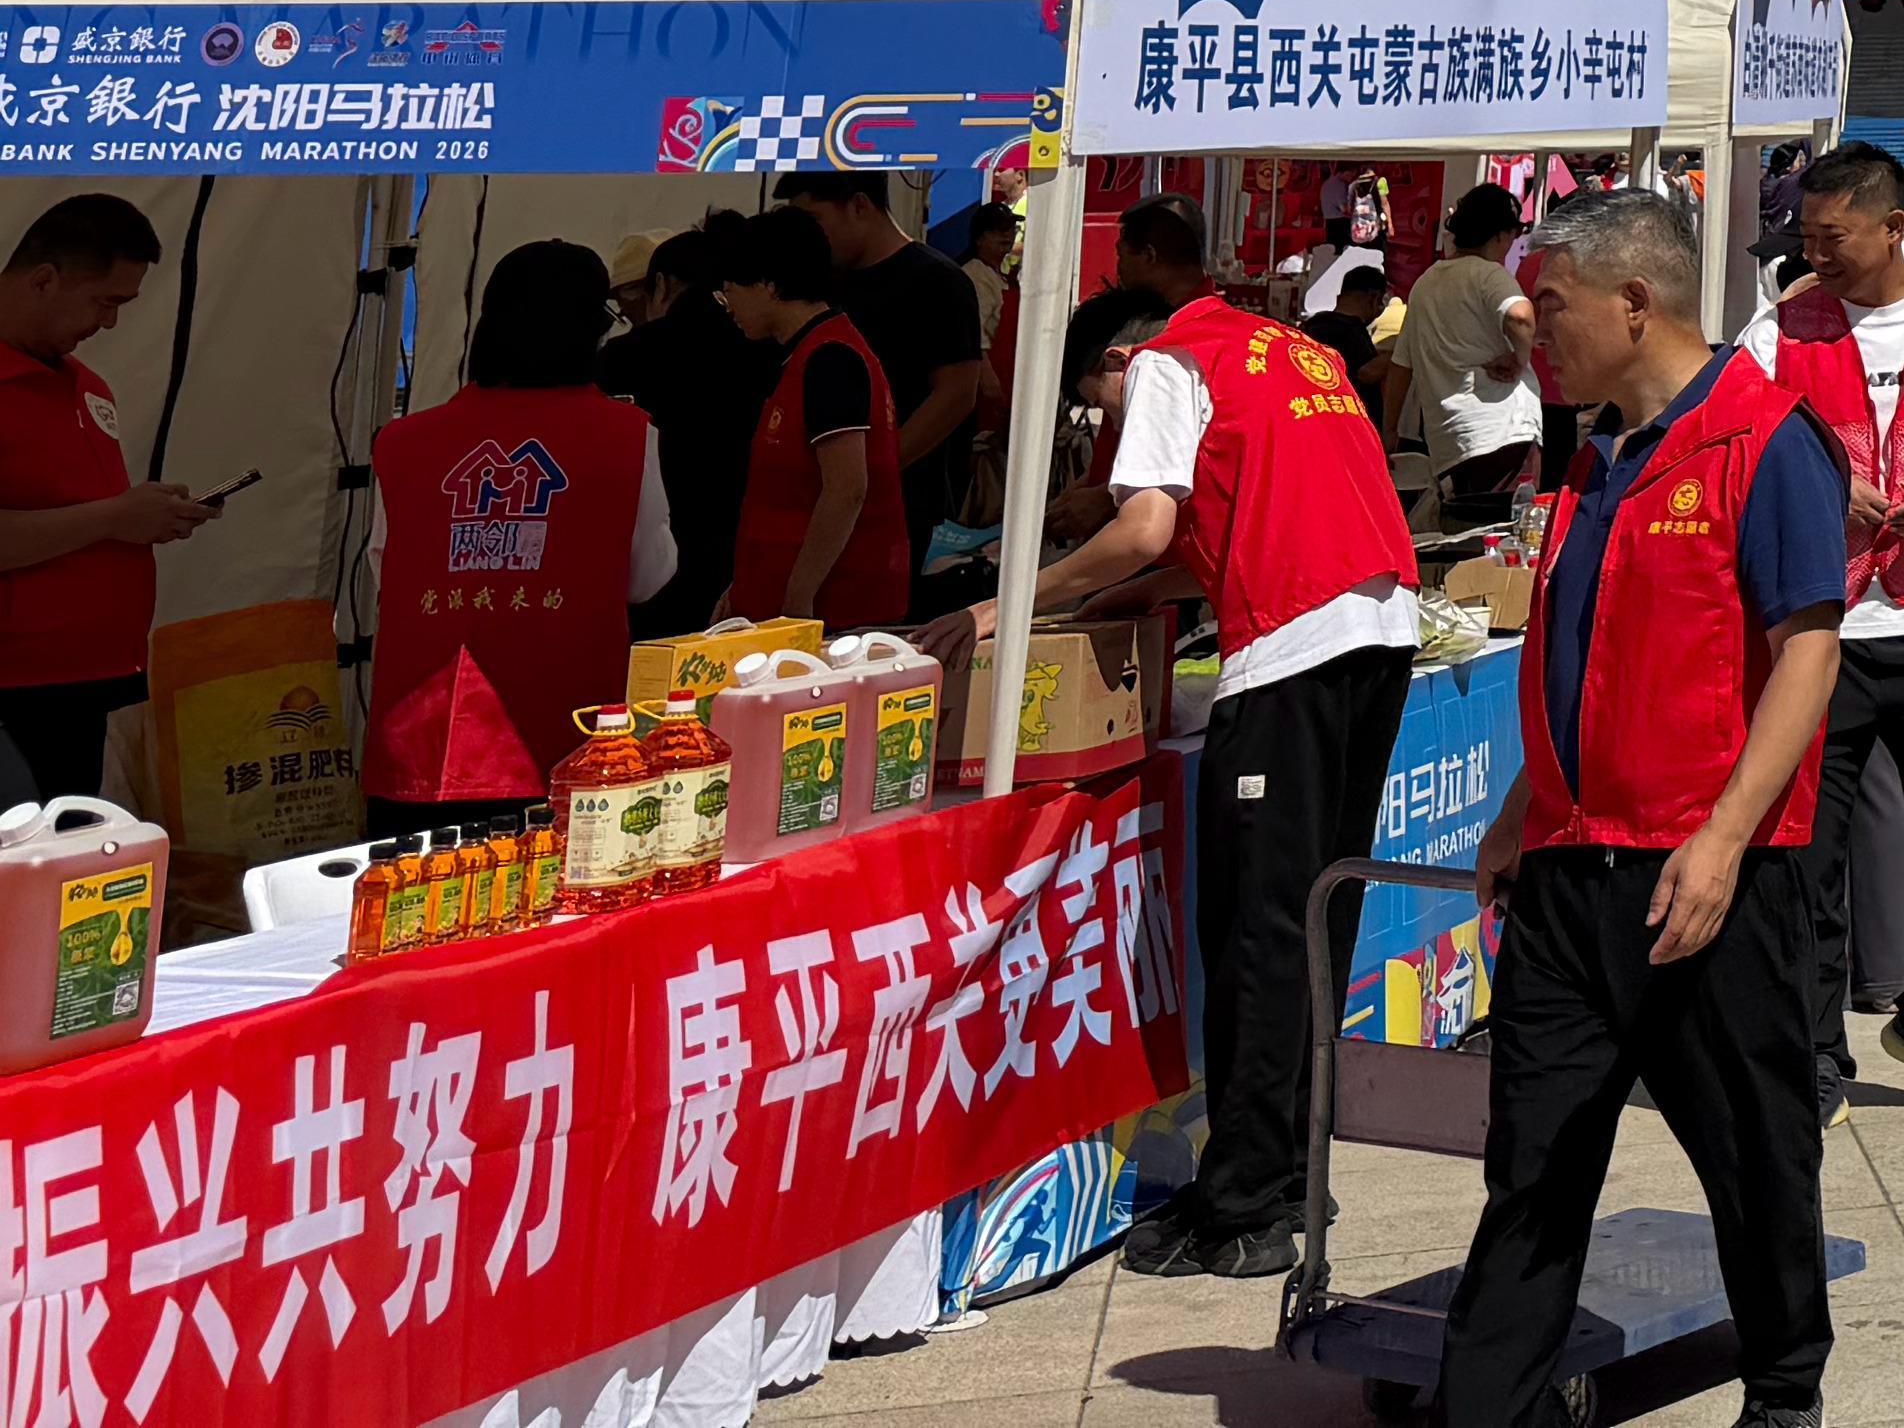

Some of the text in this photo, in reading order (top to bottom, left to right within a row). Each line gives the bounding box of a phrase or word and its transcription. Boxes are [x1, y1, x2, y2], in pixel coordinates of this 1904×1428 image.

[67, 54, 182, 64] SHENGJING BANK
[71, 25, 187, 52] 盛京銀行
[1135, 20, 1647, 115] 康平县西关屯蒙古族满族乡小辛屯村
[212, 81, 495, 131] 沈阳马拉松
[0, 141, 489, 161] BANK SHENYANG MARATHON 2026
[224, 746, 360, 795] 掺混肥料
[0, 989, 575, 1428] 振兴共努力
